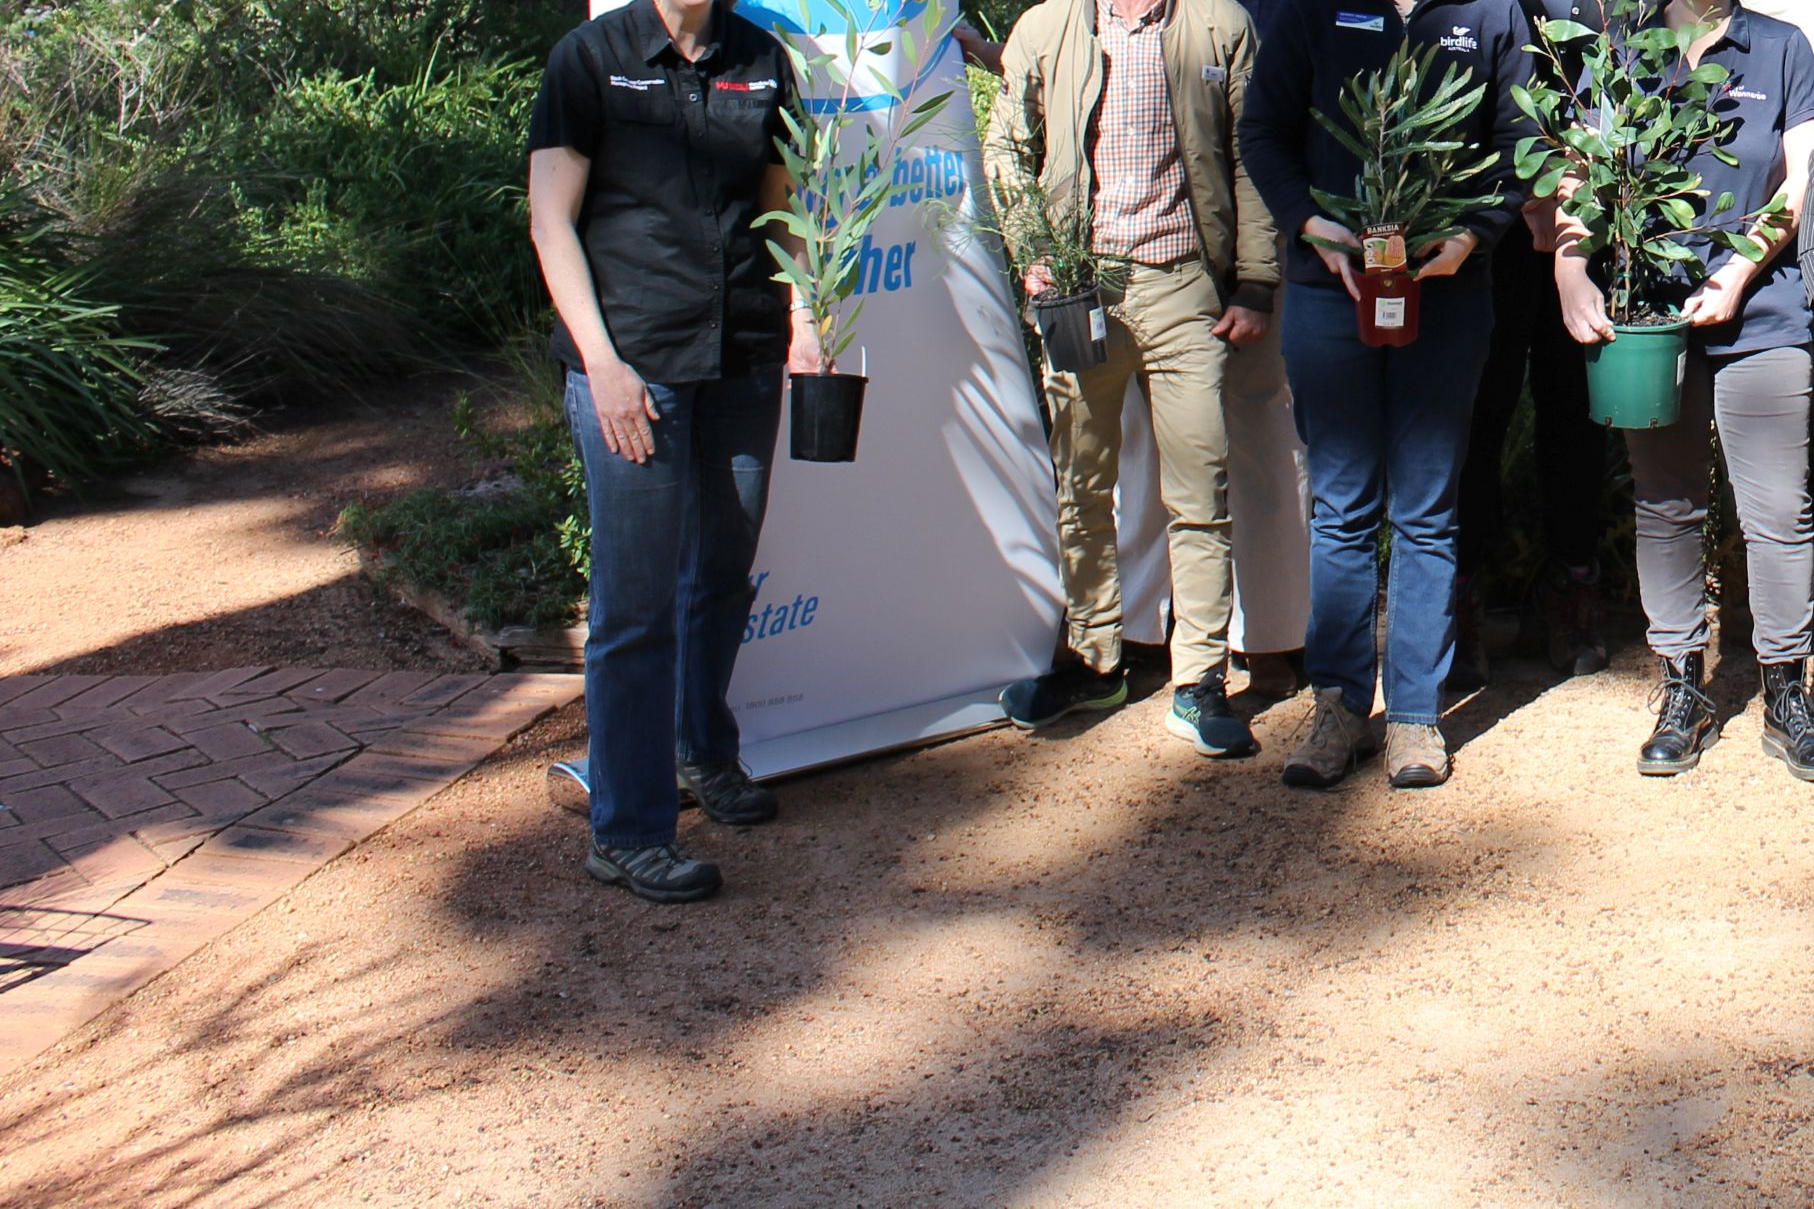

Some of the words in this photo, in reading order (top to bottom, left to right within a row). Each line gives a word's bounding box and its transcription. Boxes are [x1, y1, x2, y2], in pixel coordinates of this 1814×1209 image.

[1440, 36, 1477, 50] birdlife
[889, 145, 965, 207] better
[1367, 224, 1399, 235] BANKSIA
[740, 594, 819, 644] state
